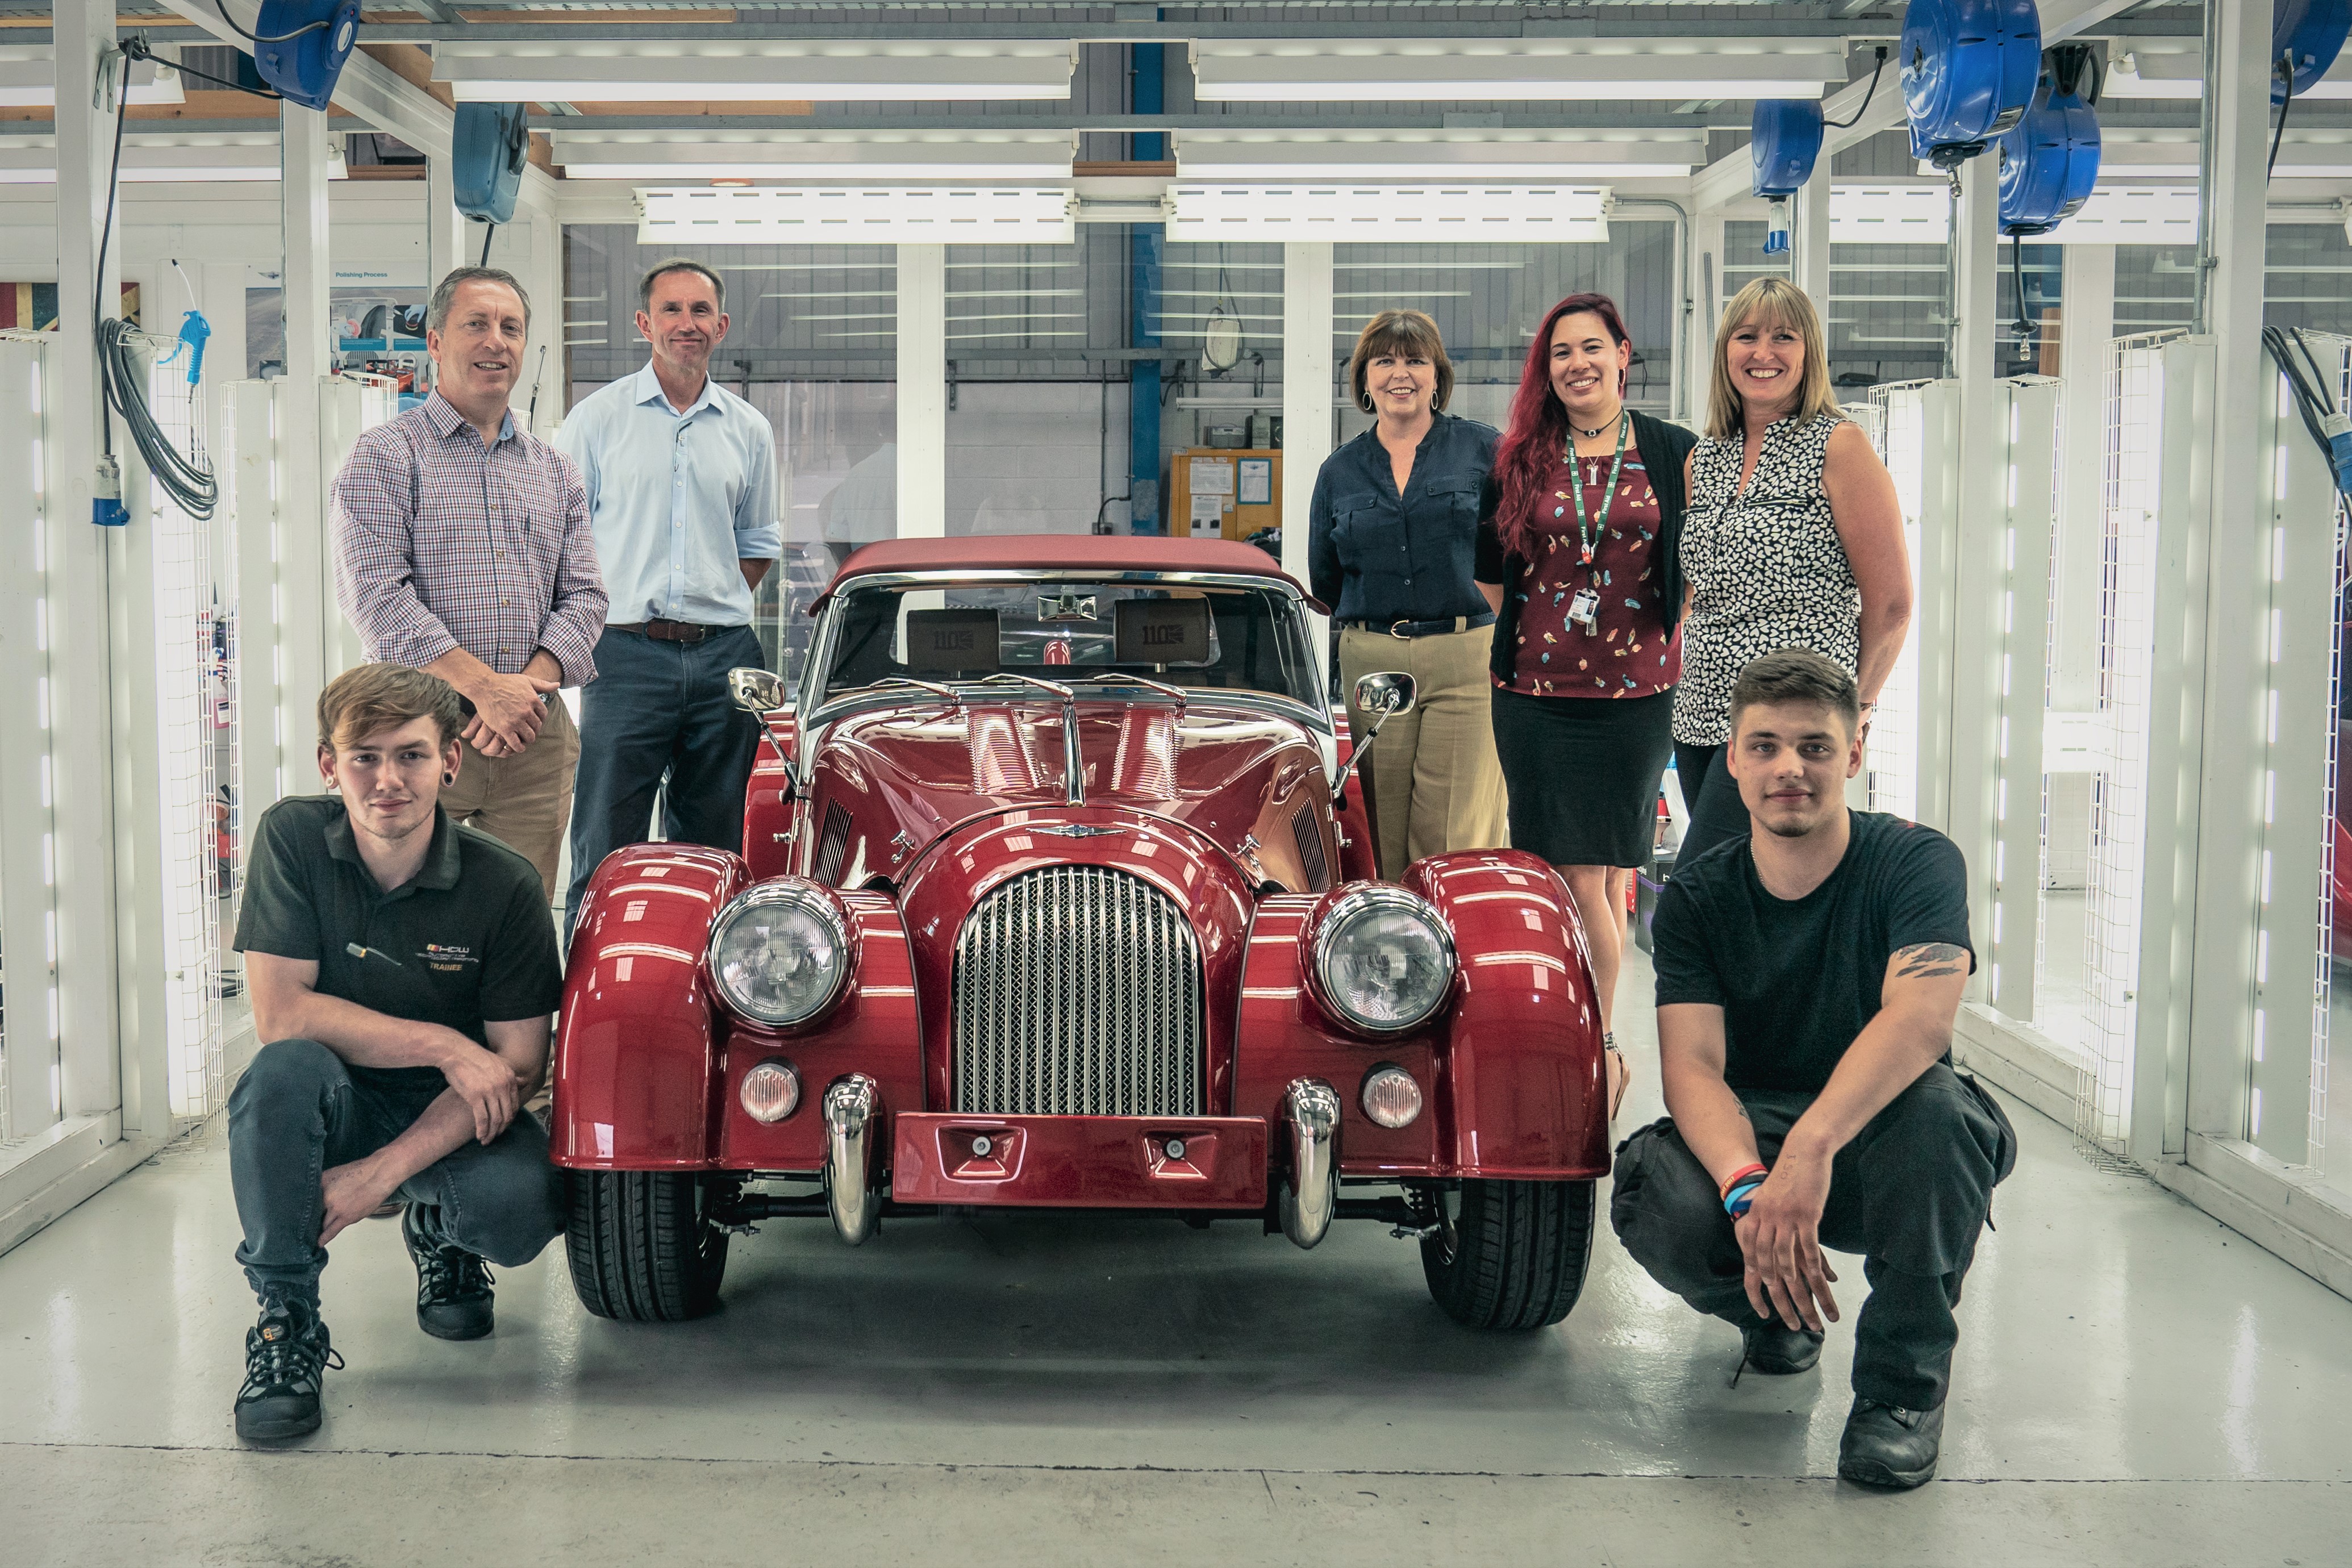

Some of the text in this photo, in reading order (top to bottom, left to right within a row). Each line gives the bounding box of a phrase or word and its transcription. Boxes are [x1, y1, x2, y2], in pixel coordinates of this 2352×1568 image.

[1142, 625, 1169, 645] 110
[429, 961, 463, 971] TRAINEE
[1724, 1175, 1735, 1188] 2017
